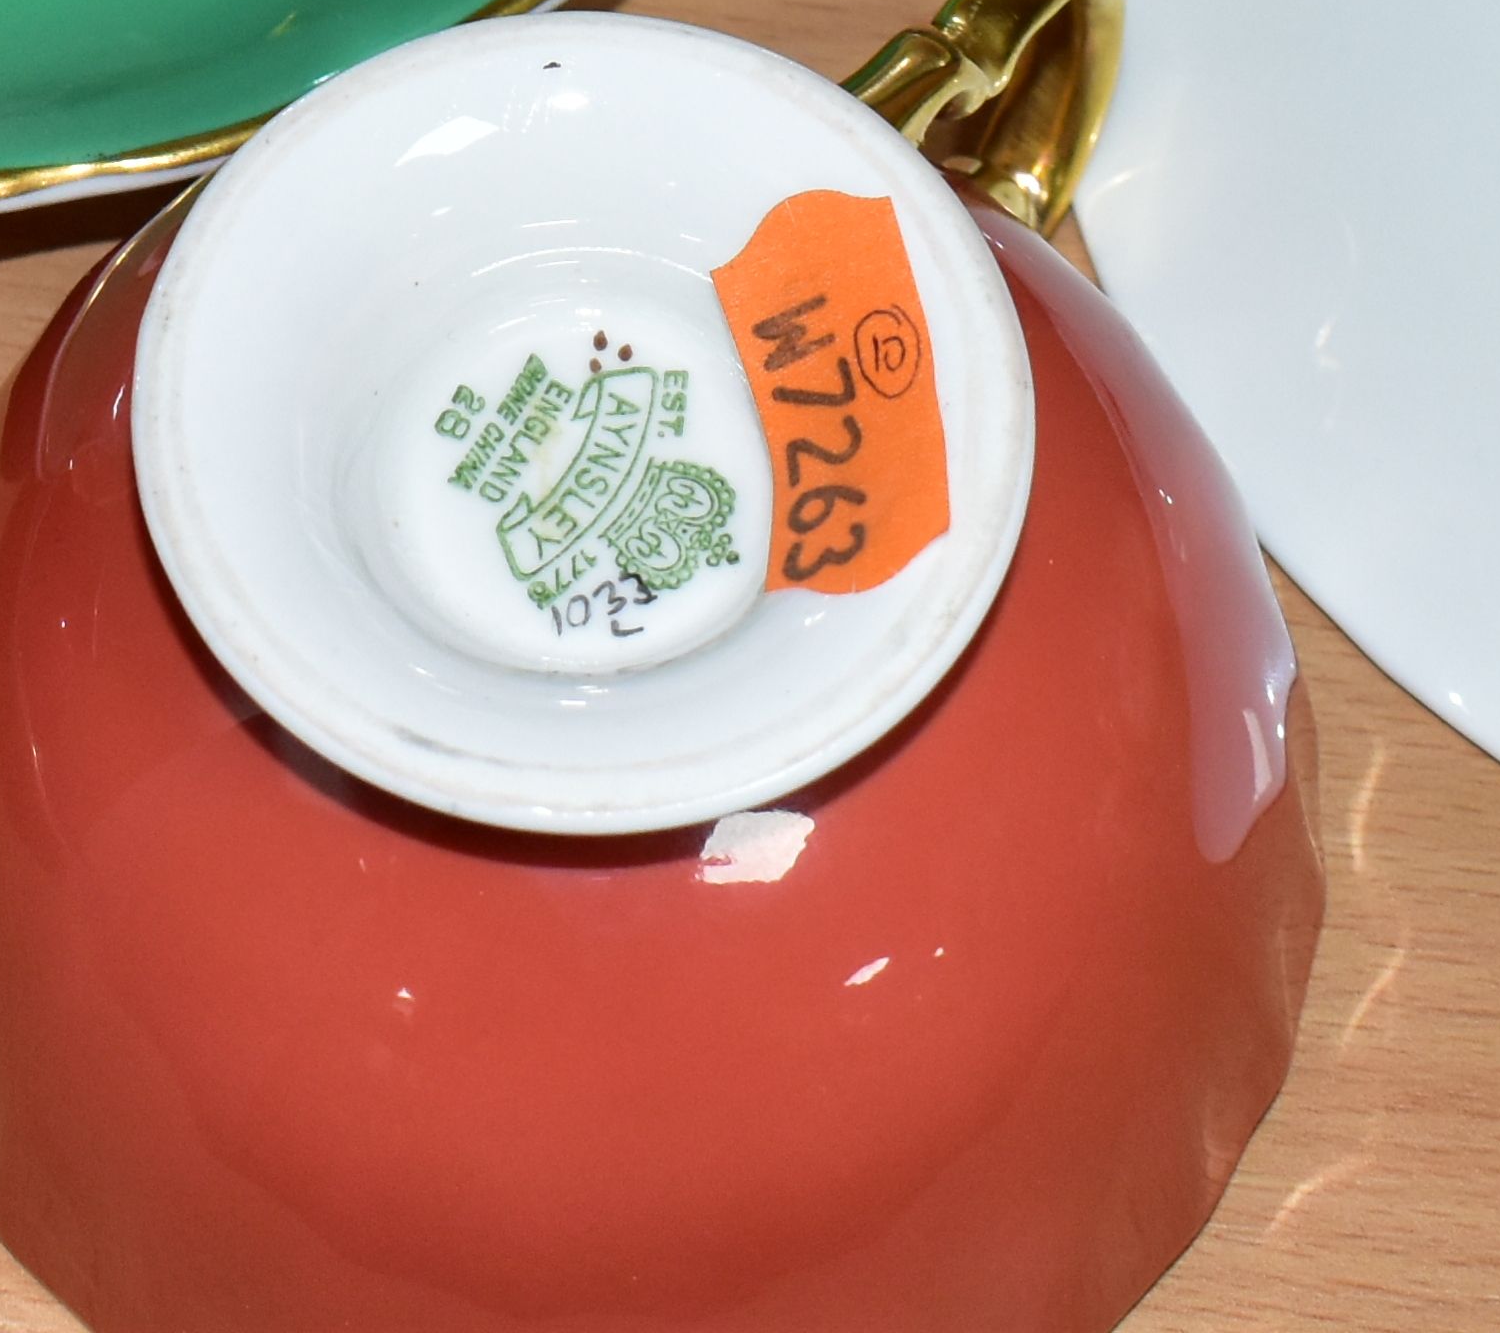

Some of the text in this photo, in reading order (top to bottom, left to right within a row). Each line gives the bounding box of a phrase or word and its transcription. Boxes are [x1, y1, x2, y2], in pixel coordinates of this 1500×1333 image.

[434, 384, 487, 440] 28
[496, 353, 549, 426] BONE
[657, 370, 690, 437] EST.
[752, 293, 868, 582] W7263
[478, 379, 575, 503] ENGLAND
[527, 392, 642, 560] AYNSLEY
